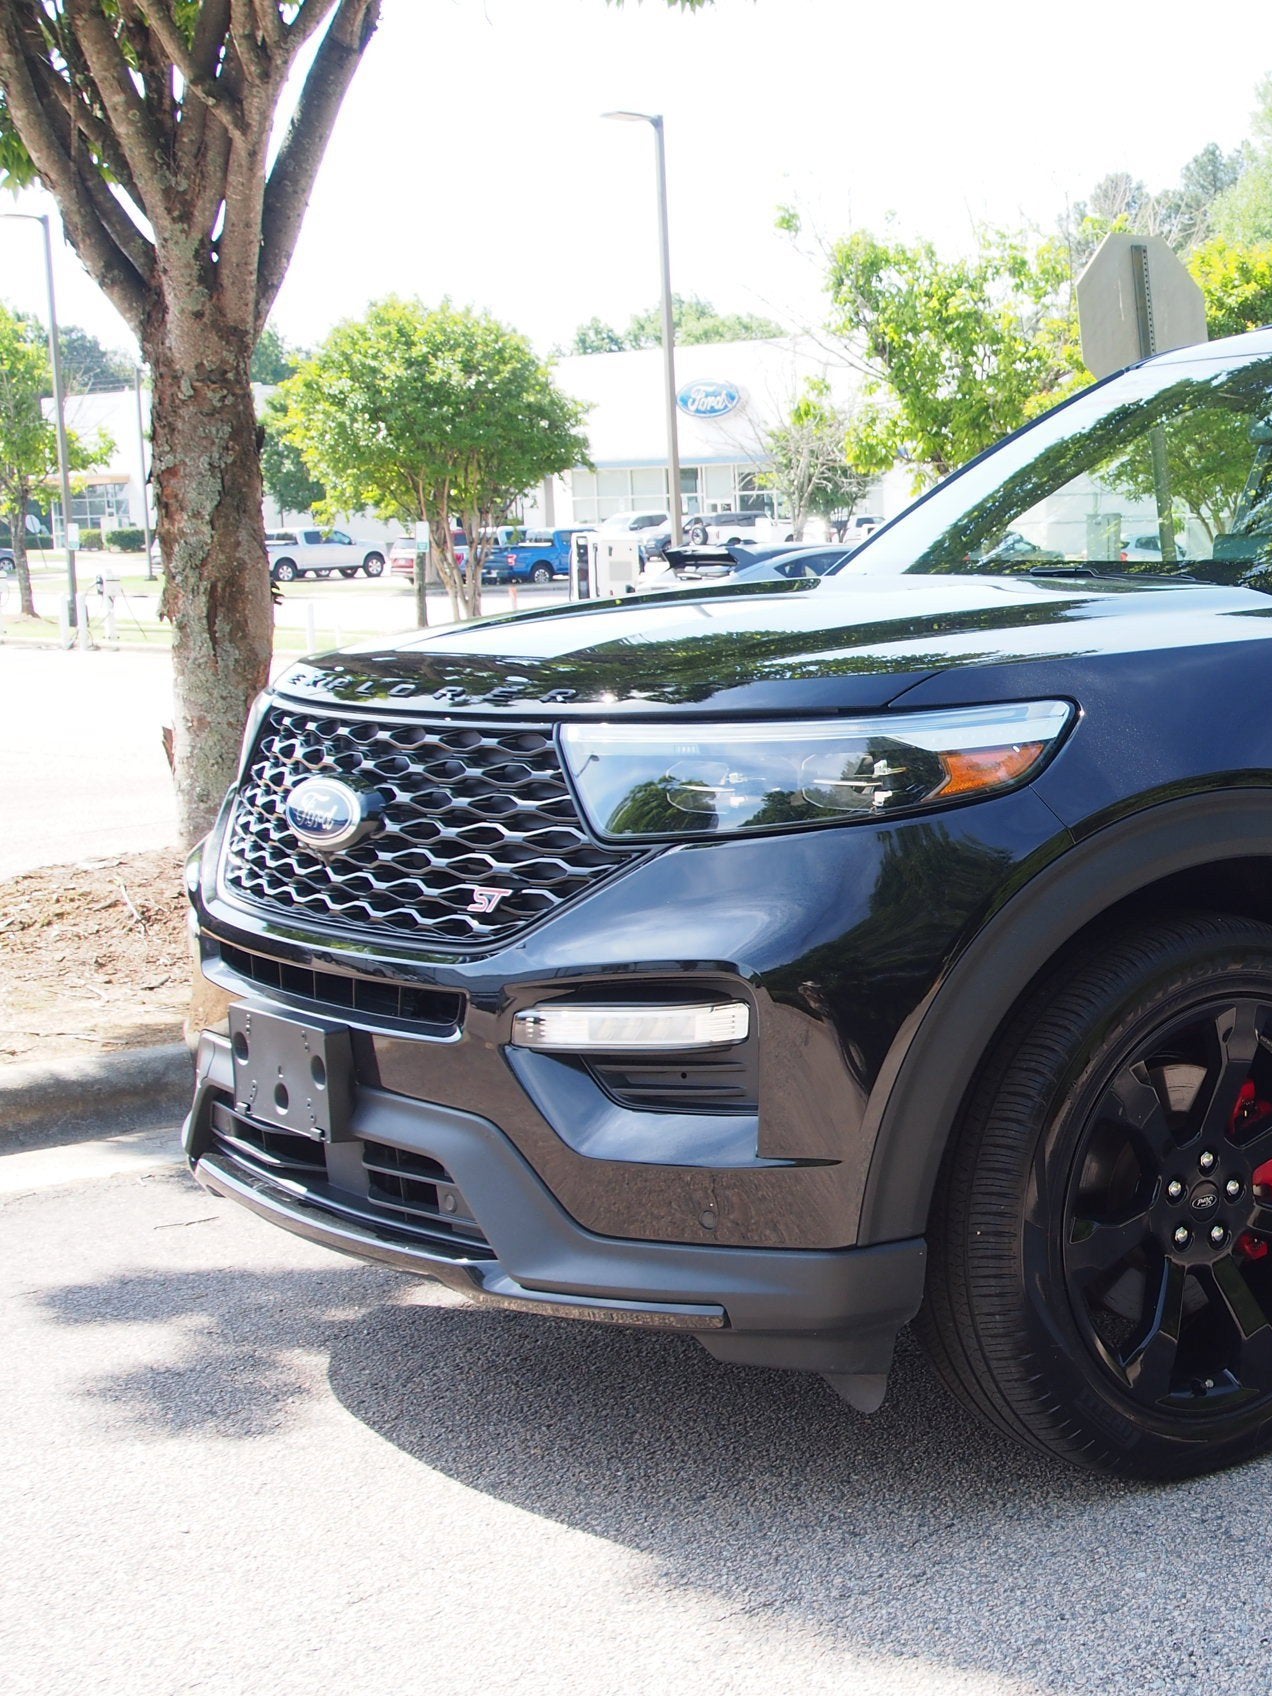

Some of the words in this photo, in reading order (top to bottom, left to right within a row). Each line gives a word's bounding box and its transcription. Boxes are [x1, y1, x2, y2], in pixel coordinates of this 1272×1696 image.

[687, 384, 732, 411] Ford
[288, 673, 577, 704] EXPLORER
[294, 792, 338, 830] Ford
[466, 886, 514, 913] ST
